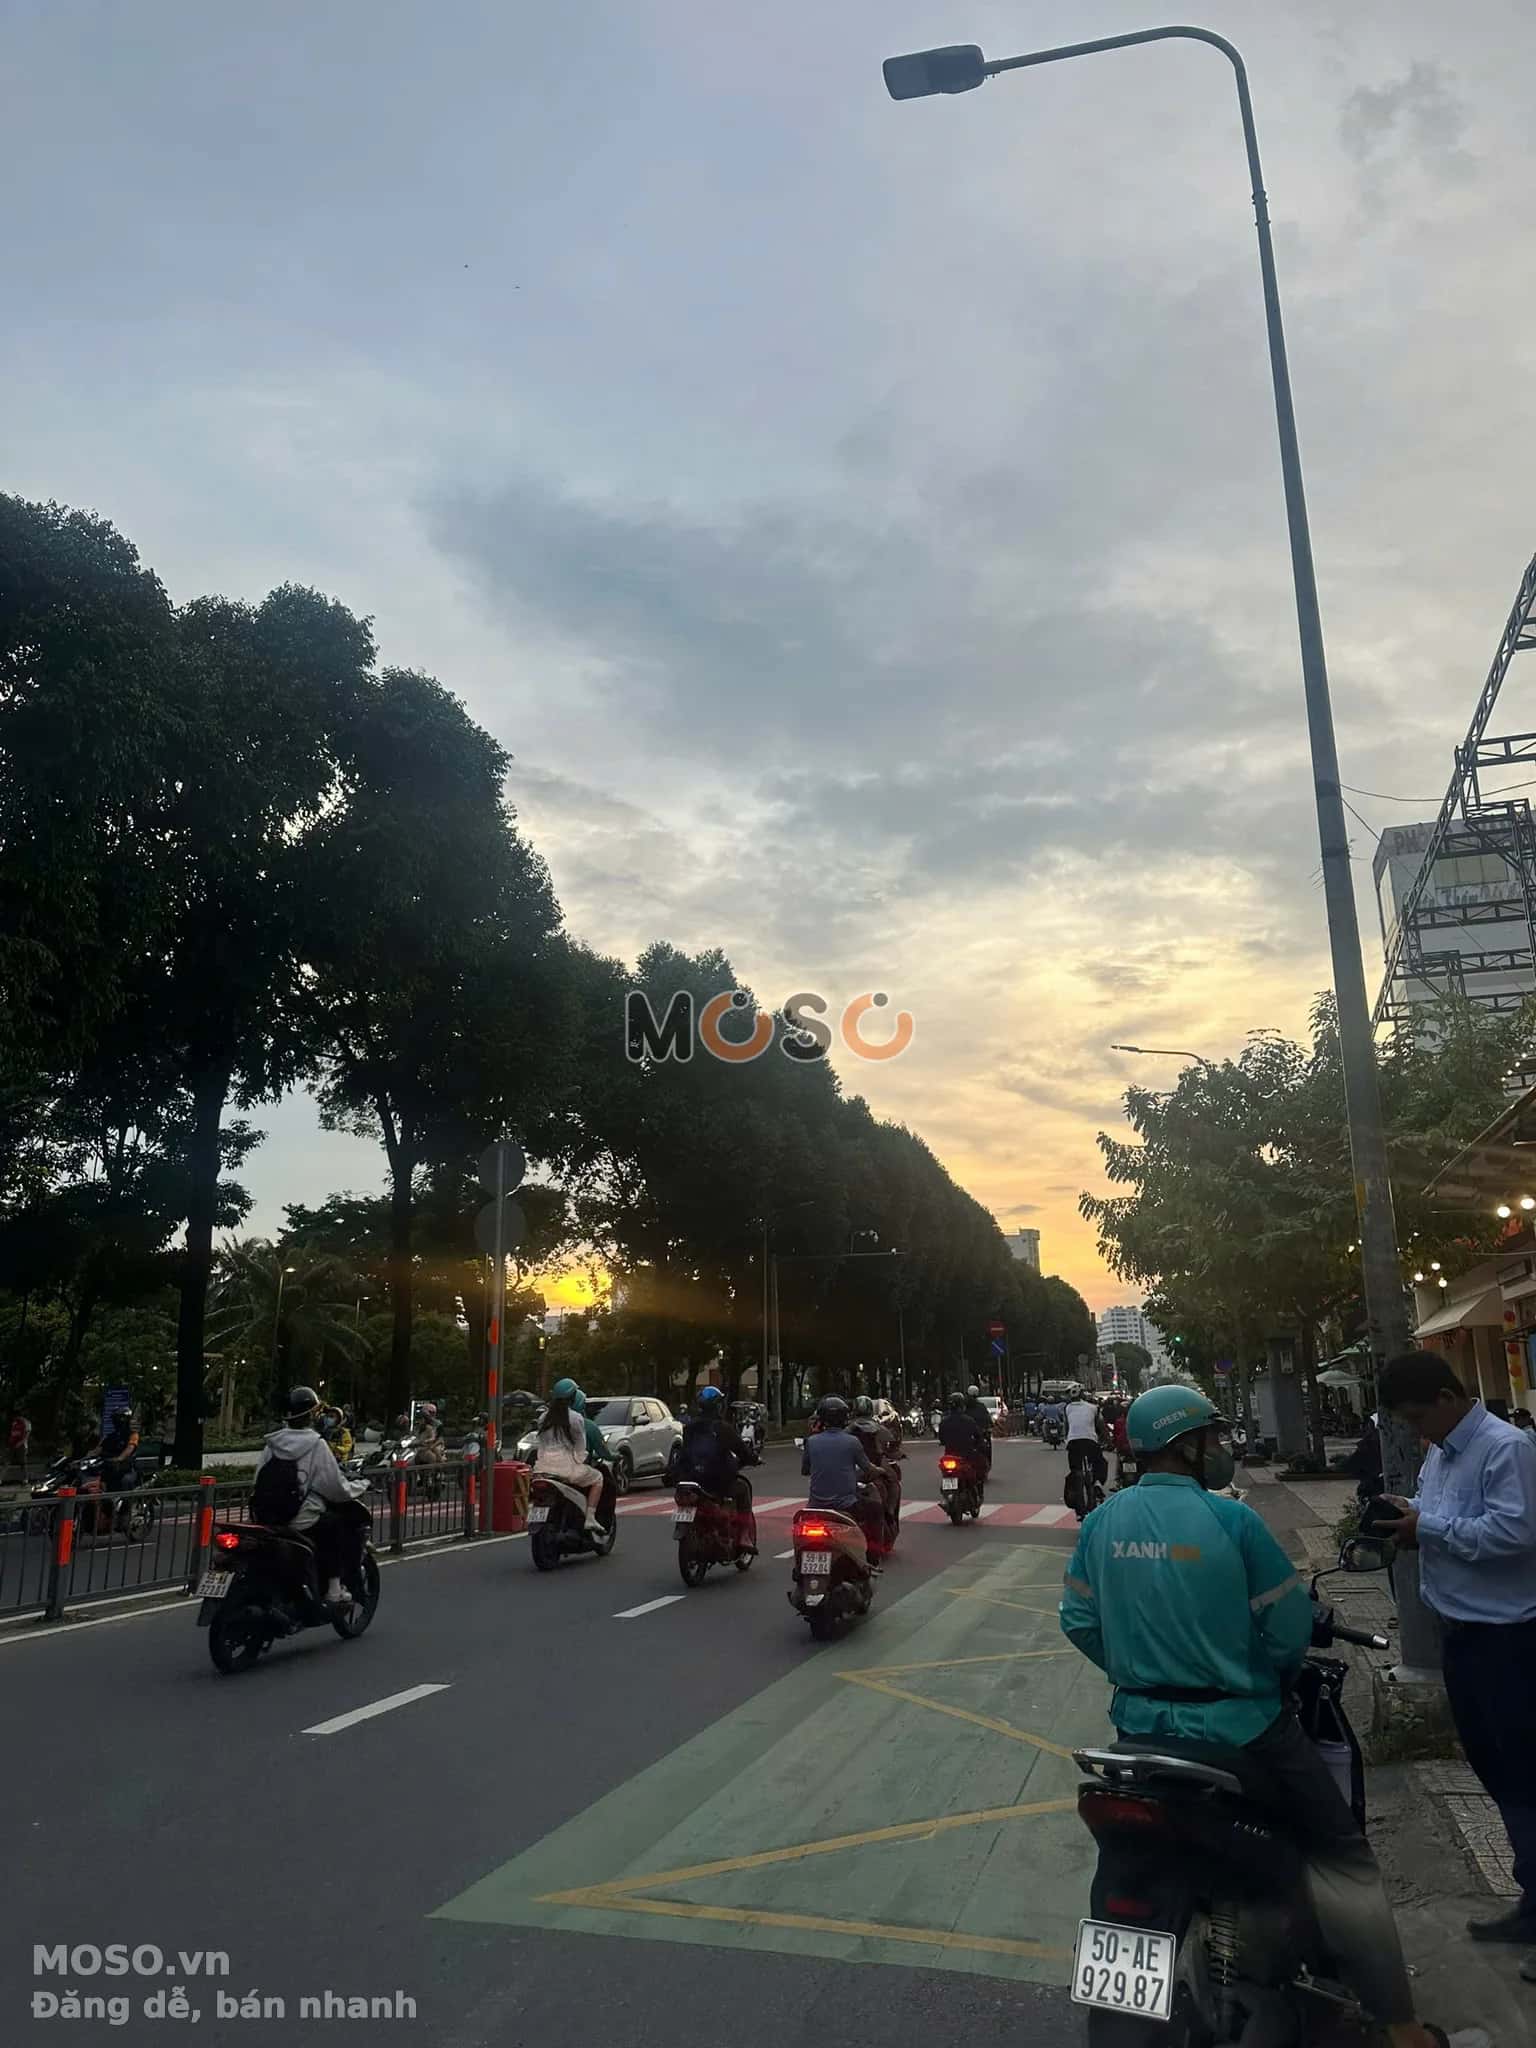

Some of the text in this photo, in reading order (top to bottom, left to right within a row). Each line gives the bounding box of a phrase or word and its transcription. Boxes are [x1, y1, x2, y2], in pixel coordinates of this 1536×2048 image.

[1152, 1408, 1187, 1430] GREEN
[1111, 1540, 1168, 1559] XANH
[1091, 1929, 1161, 1972] 50-AE
[1081, 1965, 1164, 2010] 929.87
